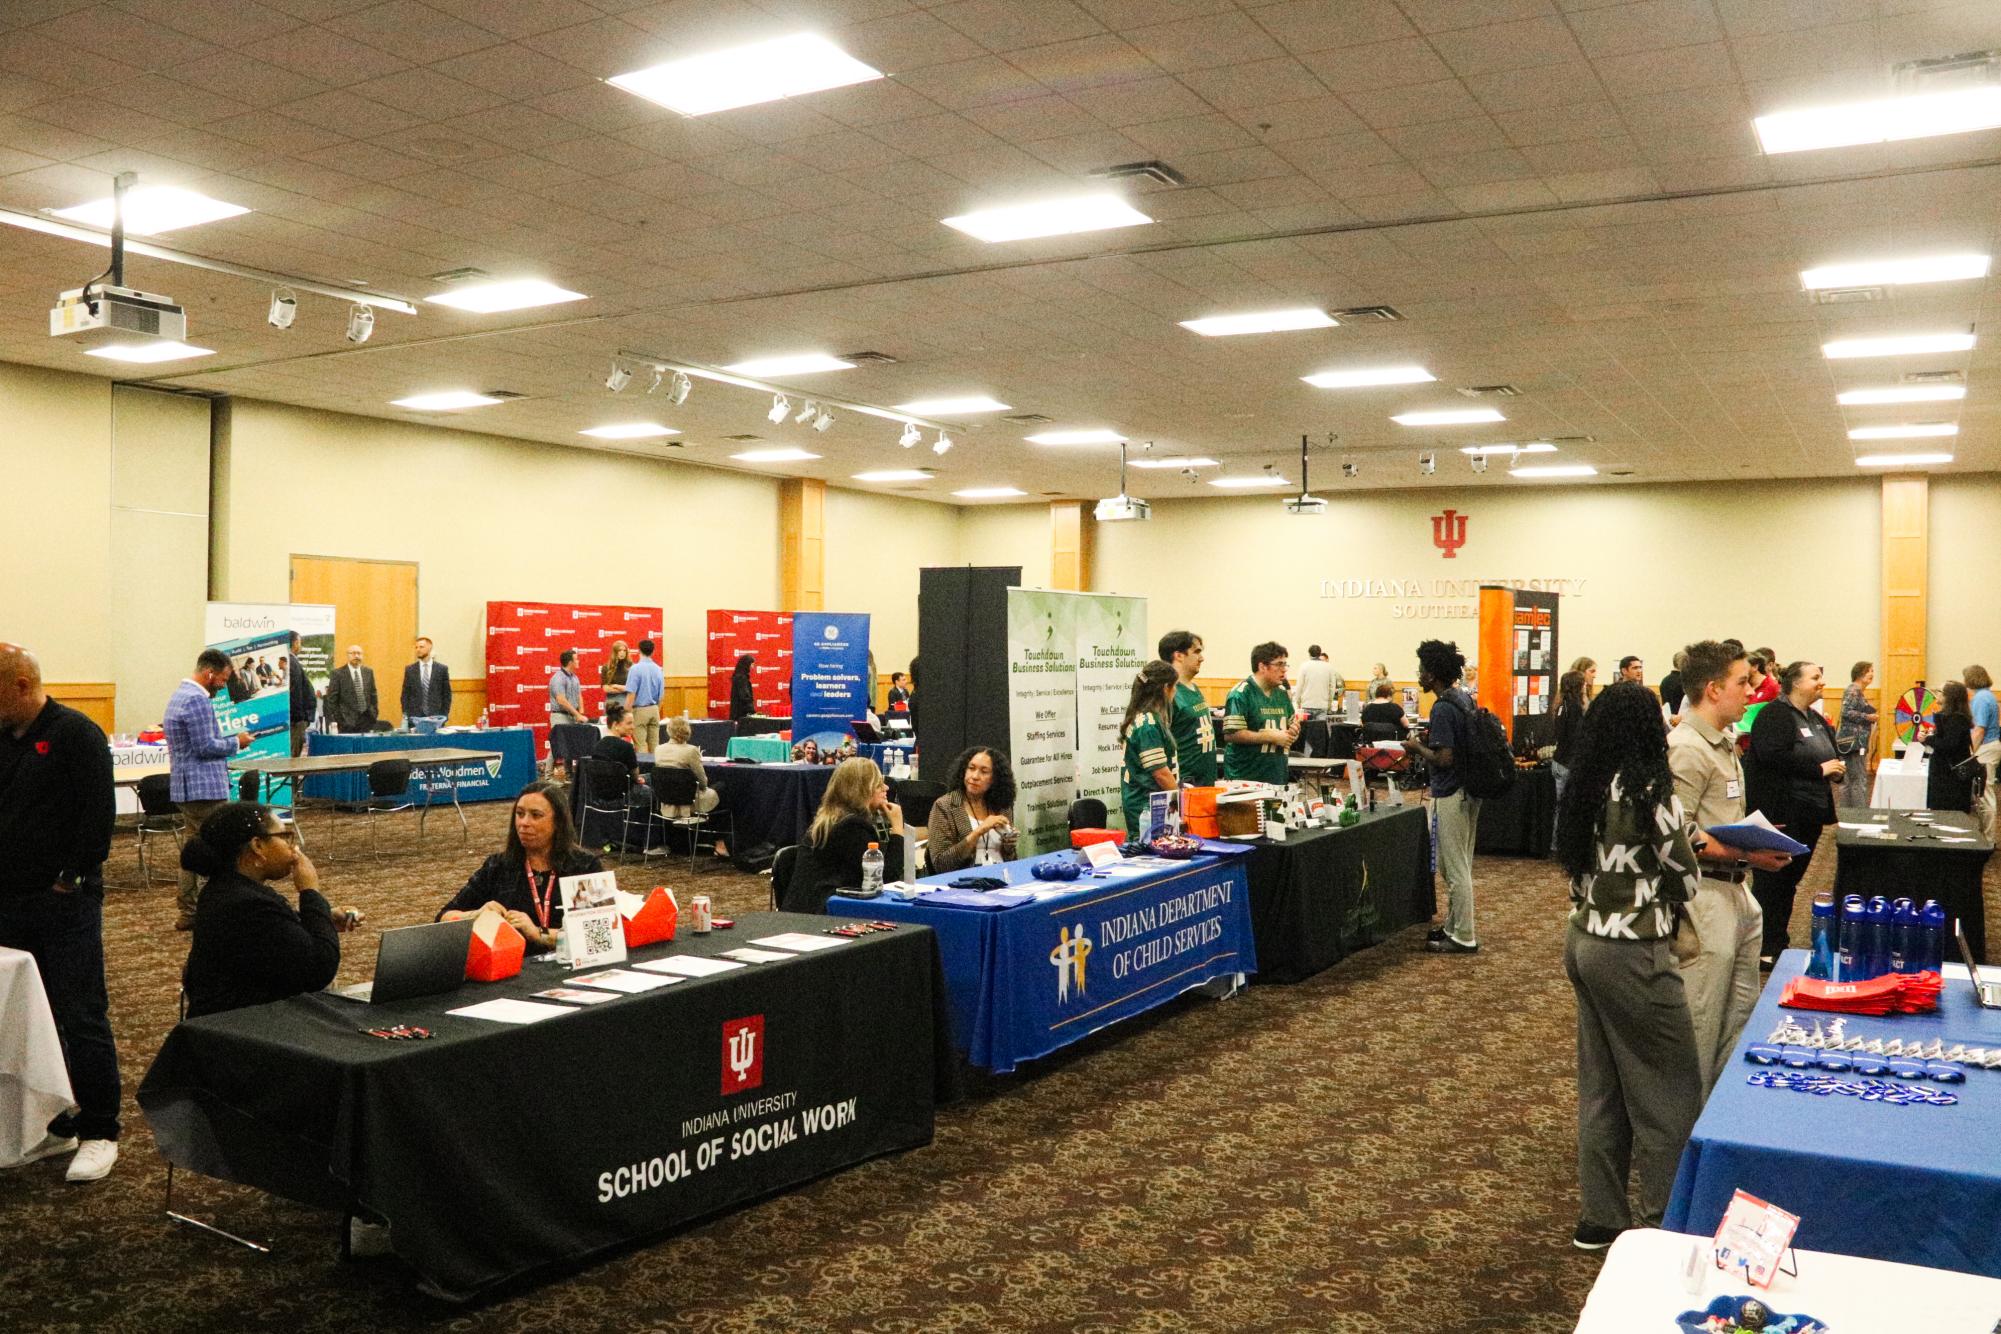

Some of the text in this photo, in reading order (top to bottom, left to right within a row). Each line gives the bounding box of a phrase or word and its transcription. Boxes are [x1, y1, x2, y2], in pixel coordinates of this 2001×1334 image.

[1319, 577, 1424, 599] INDIANA
[1391, 604, 1480, 620] SOUTHEA
[223, 616, 276, 629] baldwin
[1024, 648, 1064, 660] Touchdown
[1092, 645, 1136, 656] Touchdown
[1012, 662, 1075, 673] Business Solutions
[1080, 657, 1147, 668] Business Solutions
[801, 673, 832, 681] Problem
[815, 682, 846, 690] learners
[1083, 684, 1102, 693] Integrity
[1105, 682, 1122, 691] Service
[823, 690, 852, 698] leaders
[1035, 709, 1056, 719] We Offer
[1109, 705, 1119, 713] Can
[218, 712, 259, 732] Here
[1098, 723, 1118, 731] Resume
[1026, 729, 1066, 741] Staffing Services
[1098, 744, 1111, 752] Mock
[1020, 756, 1045, 766] Guarantee
[1060, 752, 1073, 760] Hires
[1091, 765, 1119, 775] Job Search
[457, 779, 490, 788] FINANCIAL
[1020, 775, 1074, 790] Outplacement Services
[1083, 788, 1100, 797] Direct
[1027, 801, 1046, 812] Training
[1100, 880, 1234, 948] INDIANA DEPARTMENT
[1587, 909, 1640, 940] MK
[1113, 914, 1222, 980] OF CHILD SERVICES
[682, 1090, 798, 1139] INDIANA UNIVERSITY
[597, 1096, 858, 1204] SCHOOL OF SOCIAL WORK
